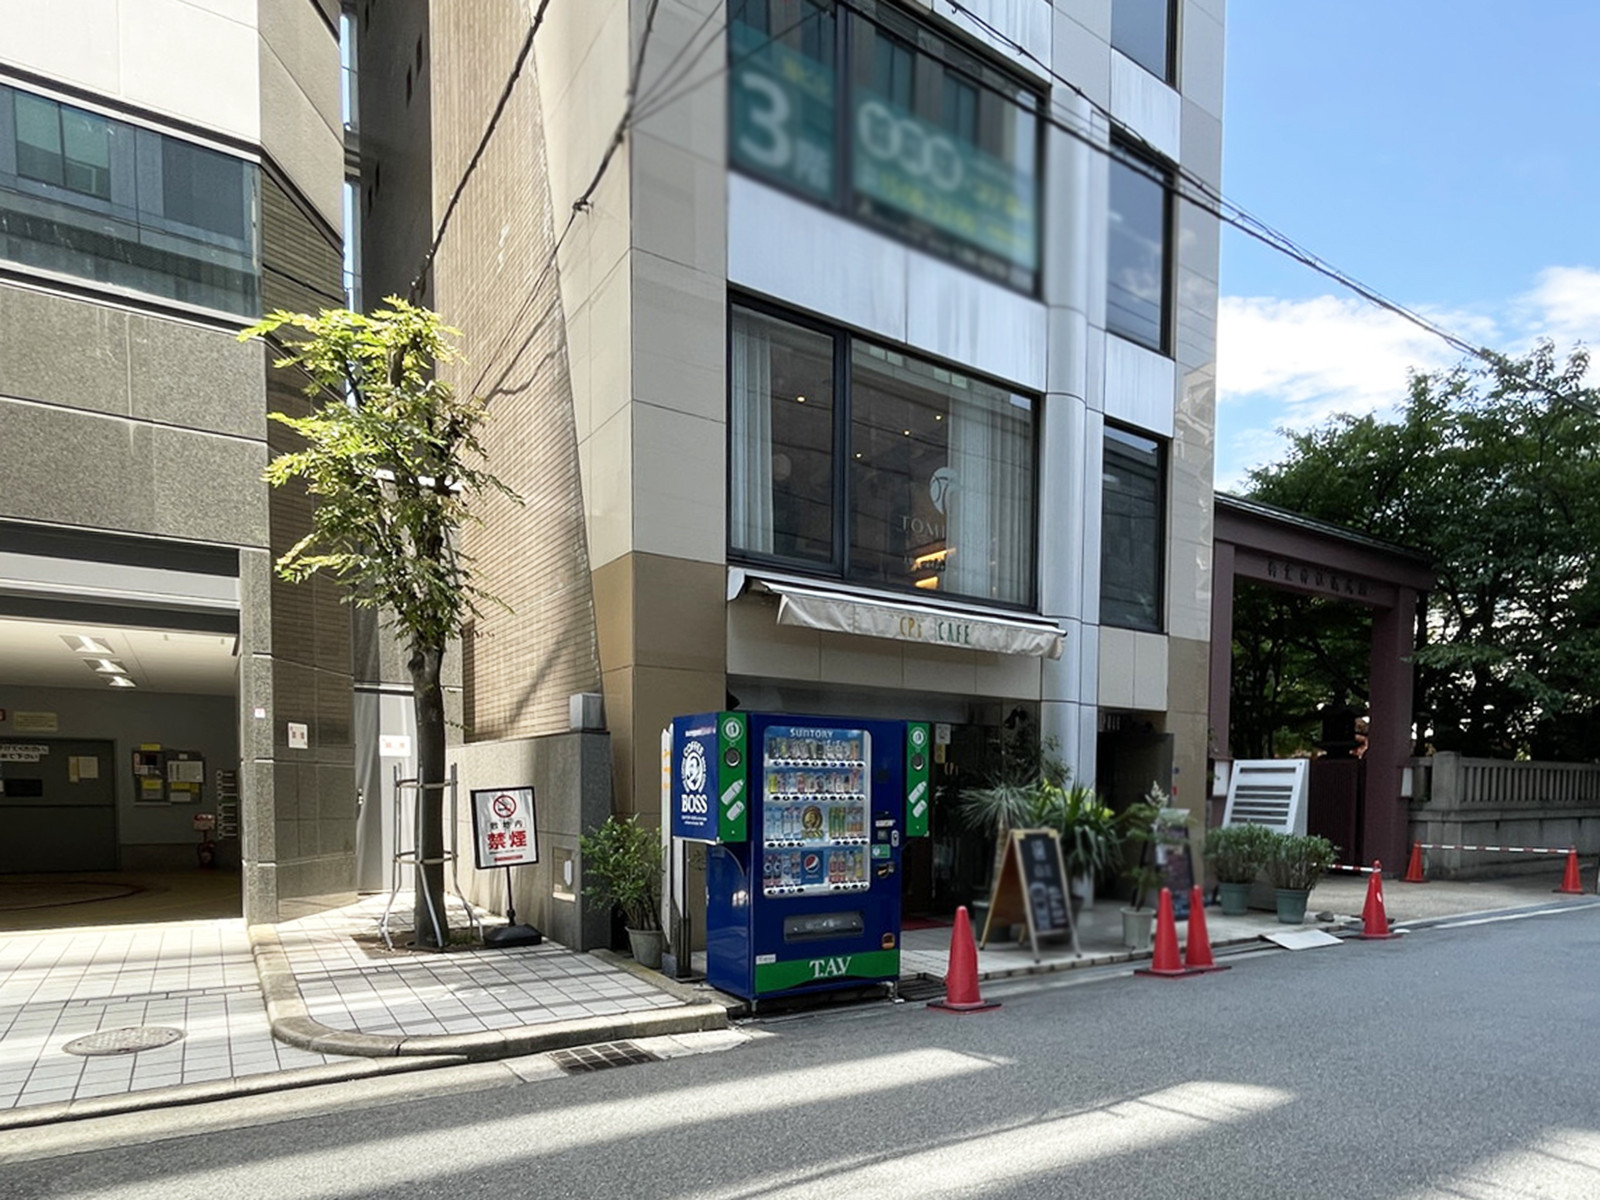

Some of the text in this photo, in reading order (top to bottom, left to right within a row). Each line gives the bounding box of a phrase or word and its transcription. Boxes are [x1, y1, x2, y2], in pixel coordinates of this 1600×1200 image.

[938, 621, 972, 644] CAFE
[790, 728, 833, 738] SUNTORY
[681, 794, 708, 813] BOSS
[488, 830, 527, 850] 禁煙
